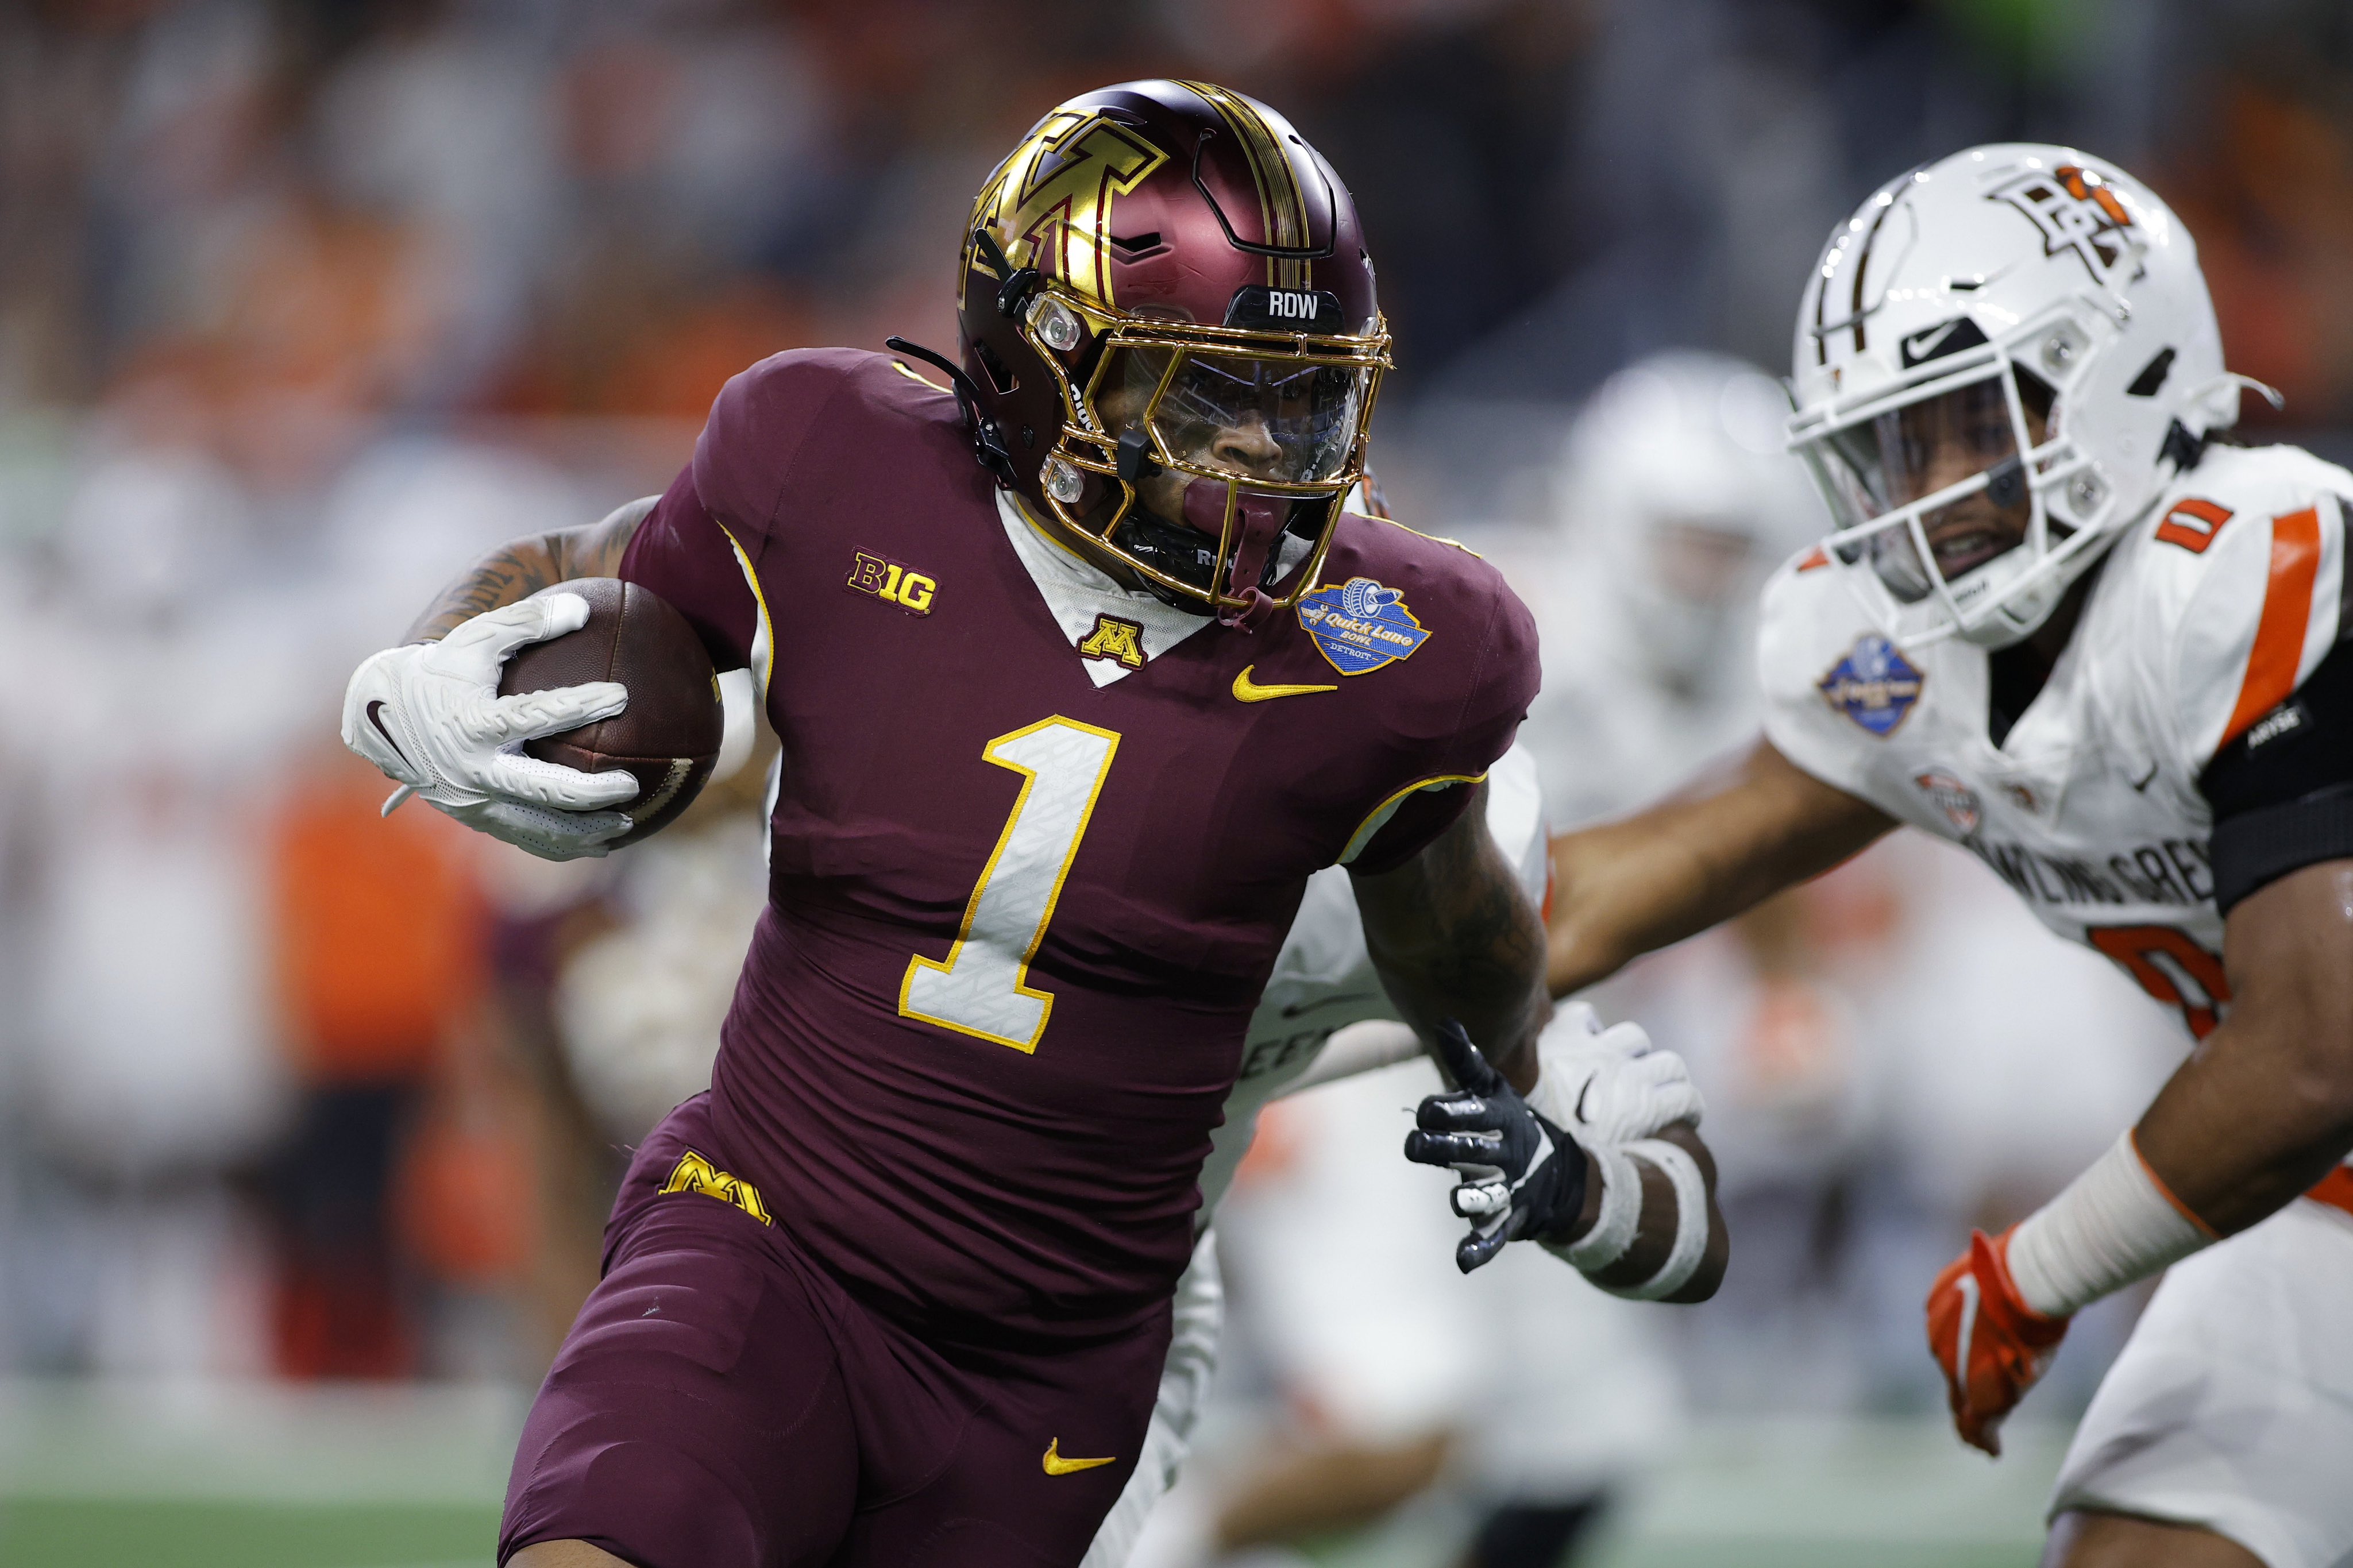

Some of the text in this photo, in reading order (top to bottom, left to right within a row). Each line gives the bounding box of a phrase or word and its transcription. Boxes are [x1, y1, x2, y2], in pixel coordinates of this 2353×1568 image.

[1269, 291, 1318, 319] ROW
[1081, 618, 1142, 666] M
[1325, 613, 1414, 647] Quick Lane
[1340, 631, 1373, 646] BOWL
[1330, 643, 1372, 661] DETROIT
[898, 714, 1121, 1055] 1
